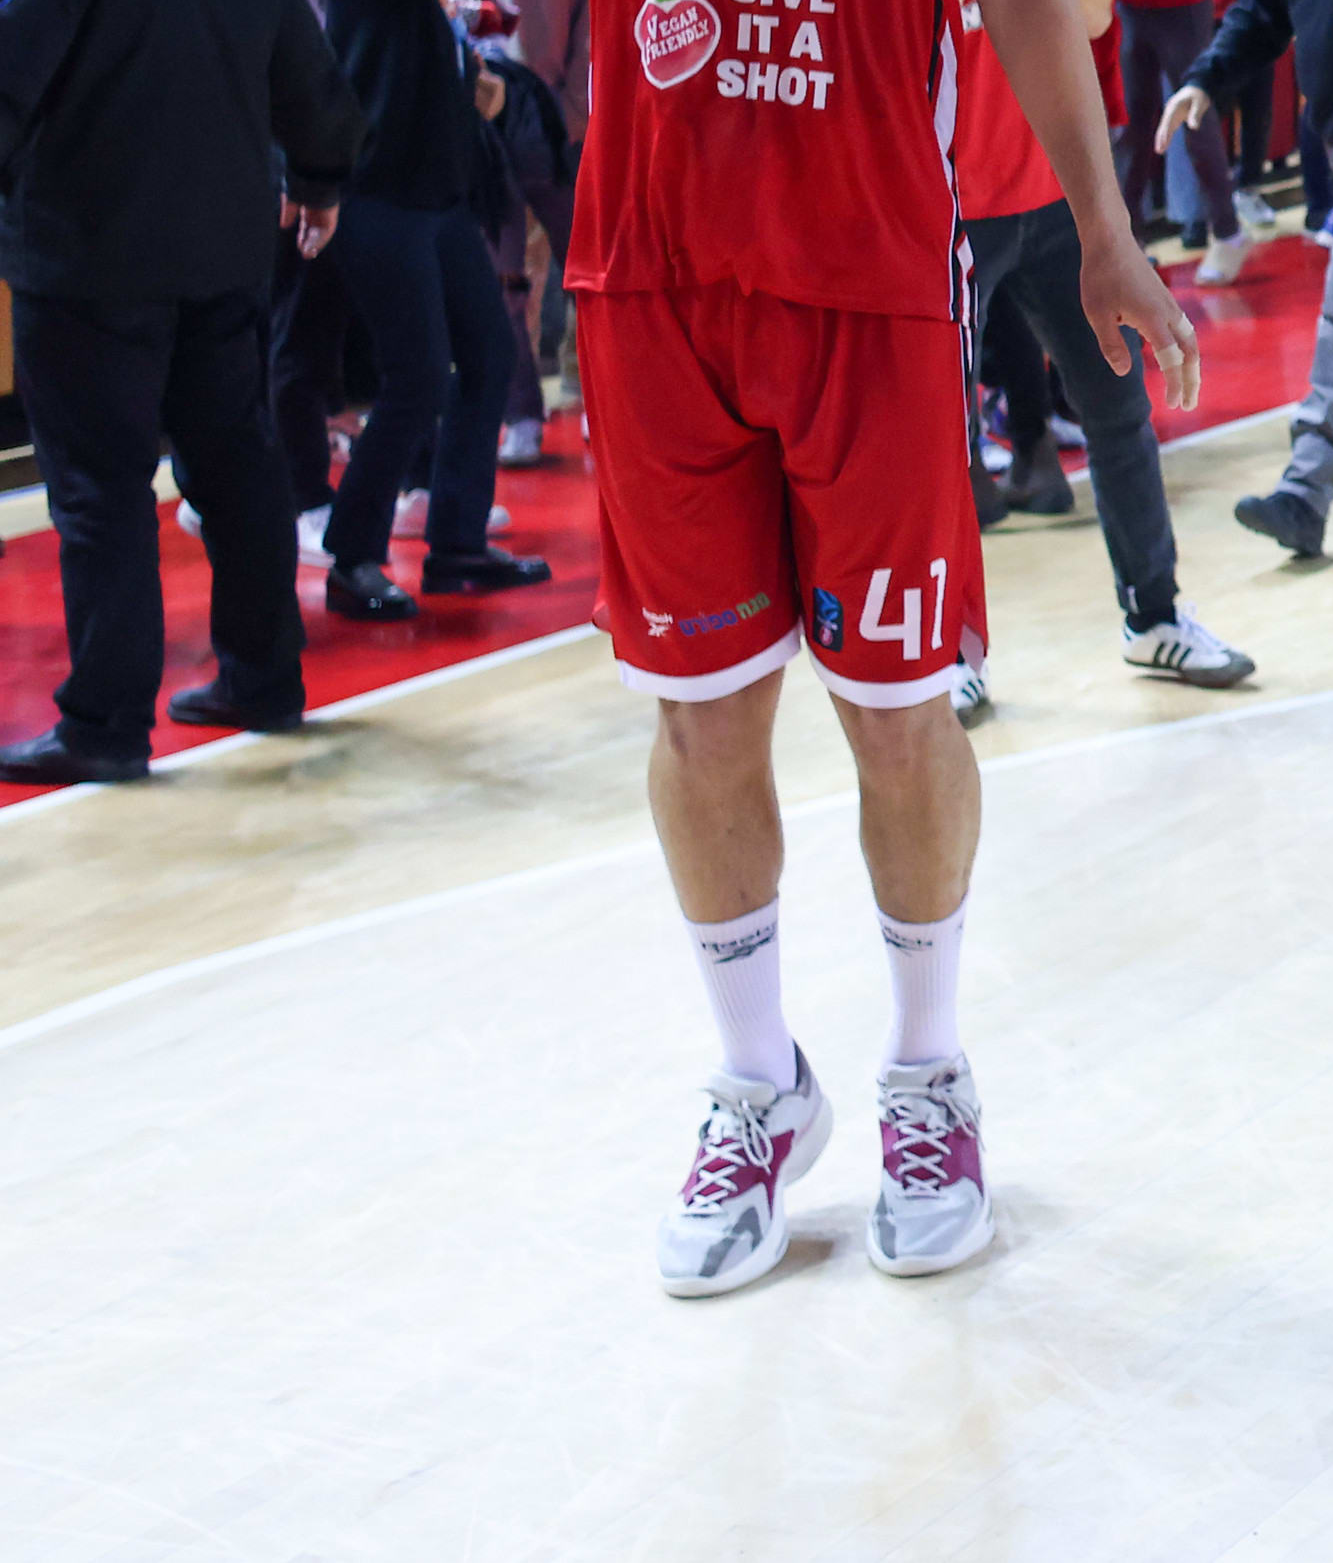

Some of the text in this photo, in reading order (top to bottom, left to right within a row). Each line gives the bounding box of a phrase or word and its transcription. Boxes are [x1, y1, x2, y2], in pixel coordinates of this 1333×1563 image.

[647, 6, 698, 41] VEGAN
[737, 13, 823, 62] IT A
[716, 58, 835, 110] SHOT
[859, 557, 947, 661] 41
